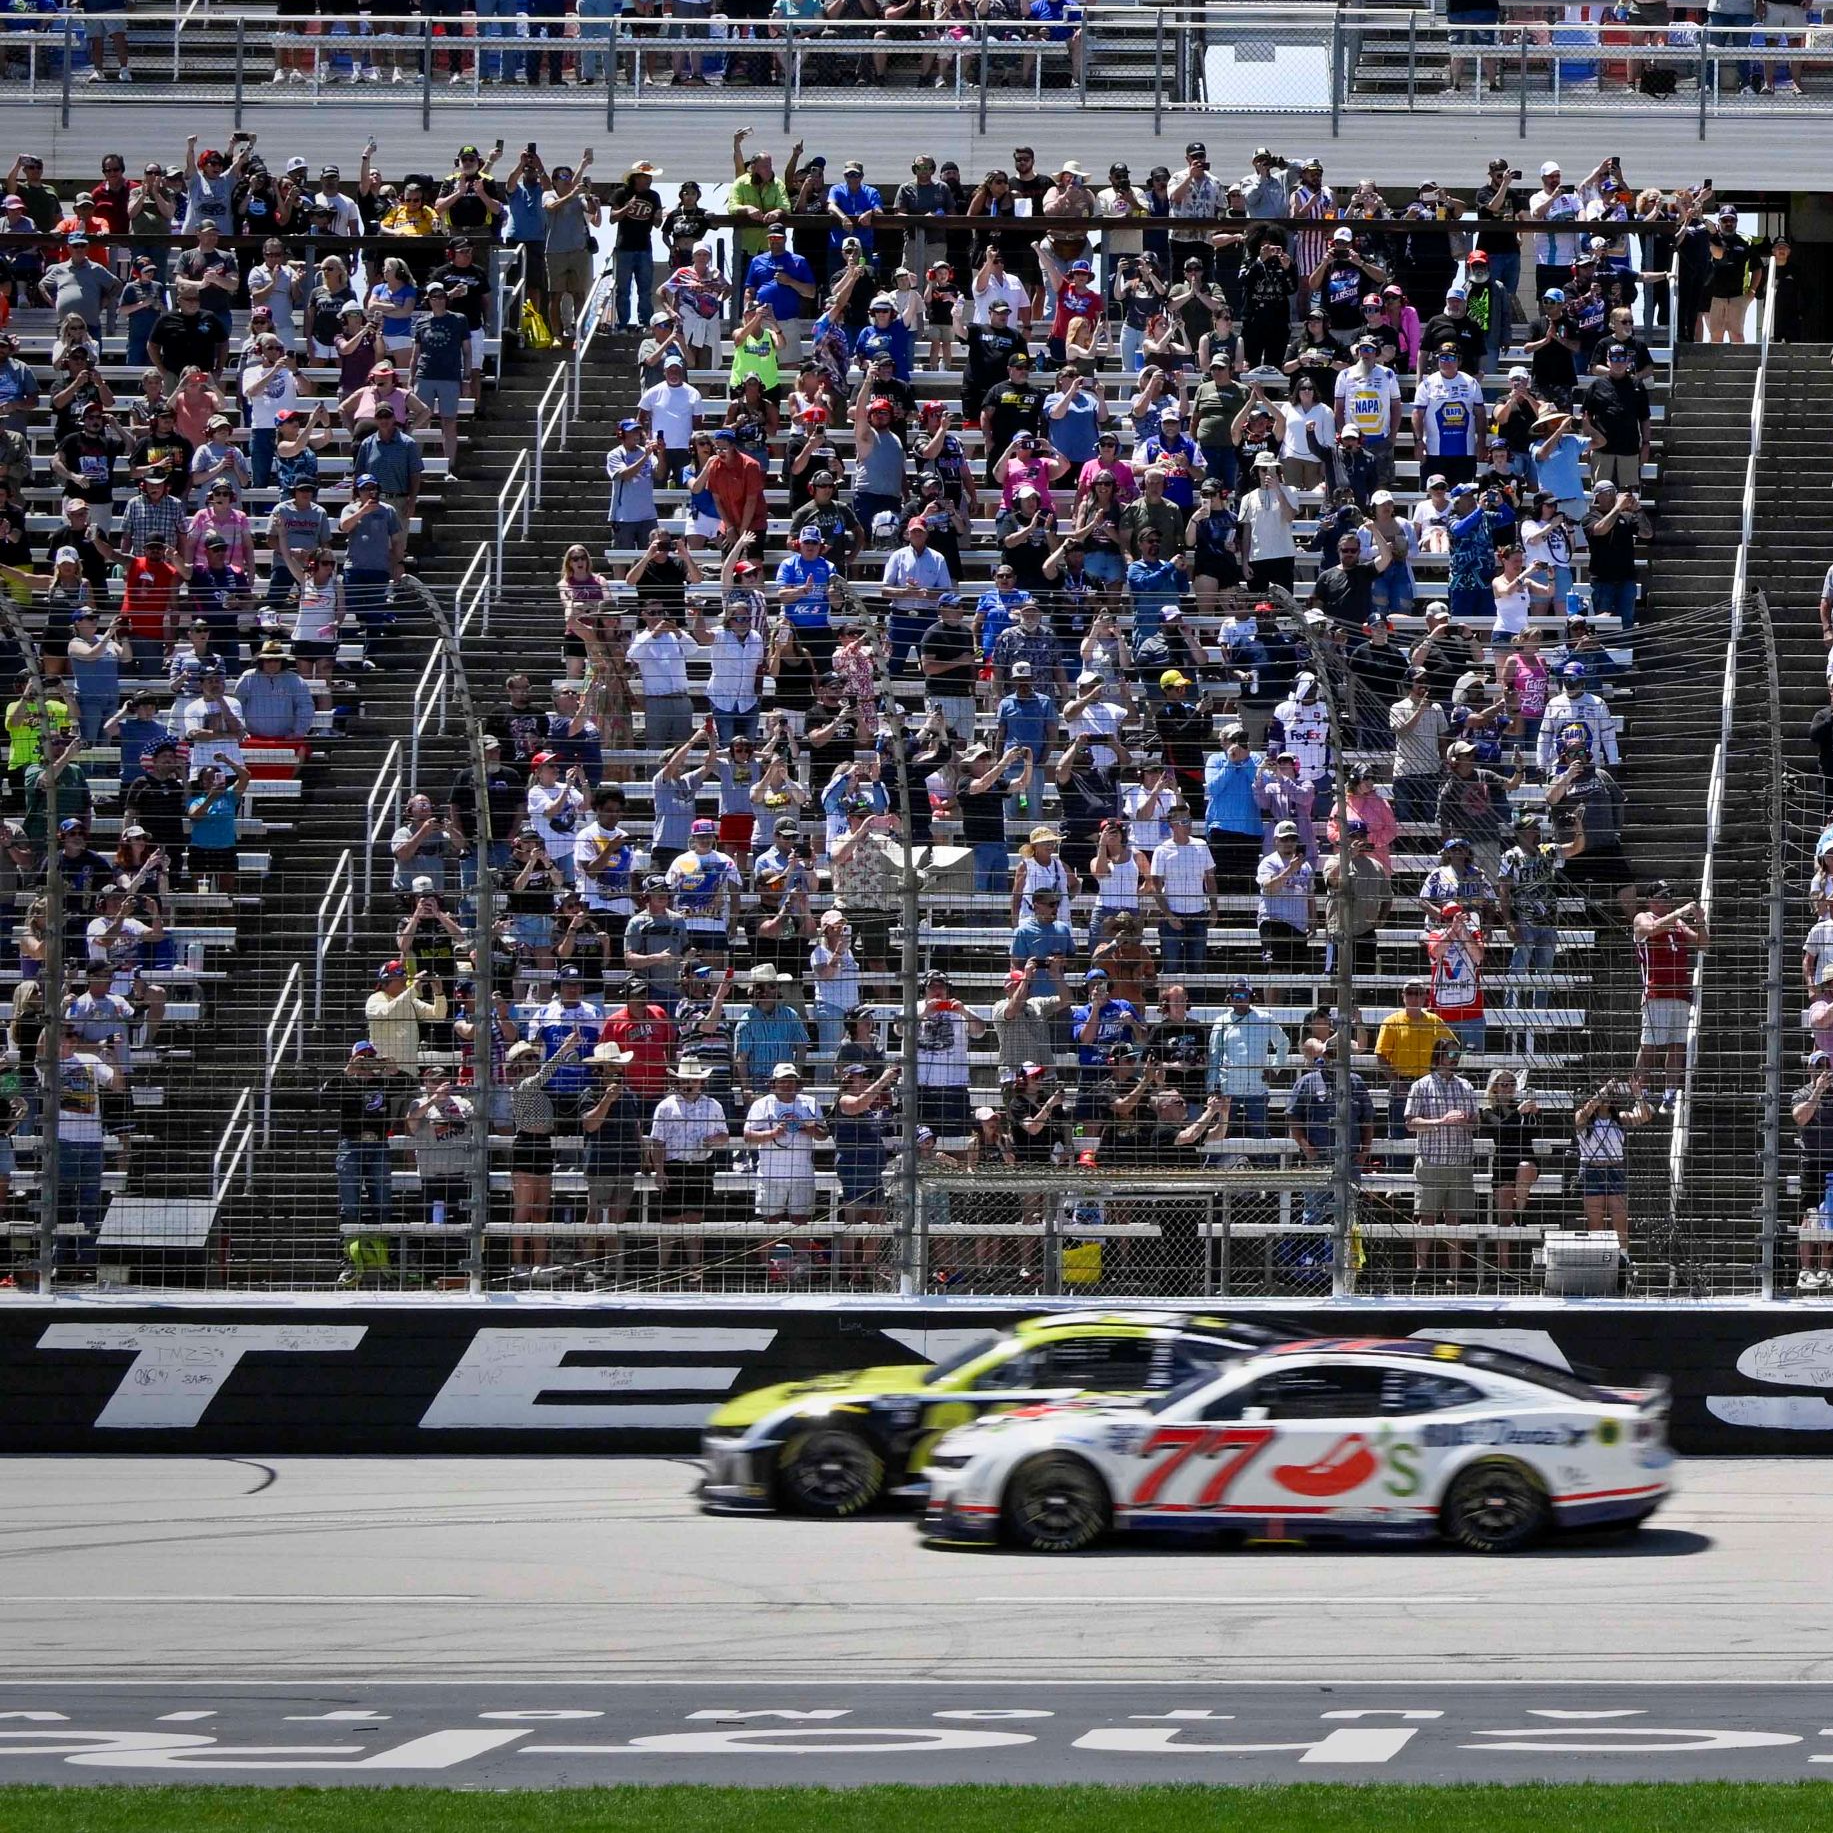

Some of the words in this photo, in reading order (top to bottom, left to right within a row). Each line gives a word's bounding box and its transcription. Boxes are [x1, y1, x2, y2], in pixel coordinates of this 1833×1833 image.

[1331, 287, 1359, 305] LARSON
[1578, 313, 1604, 329] LARSON
[1024, 396, 1036, 405] 20
[1355, 400, 1380, 414] NAPA
[1445, 407, 1462, 417] NAPA
[1290, 732, 1321, 744] FedEx
[1132, 1426, 1275, 1506] 77
